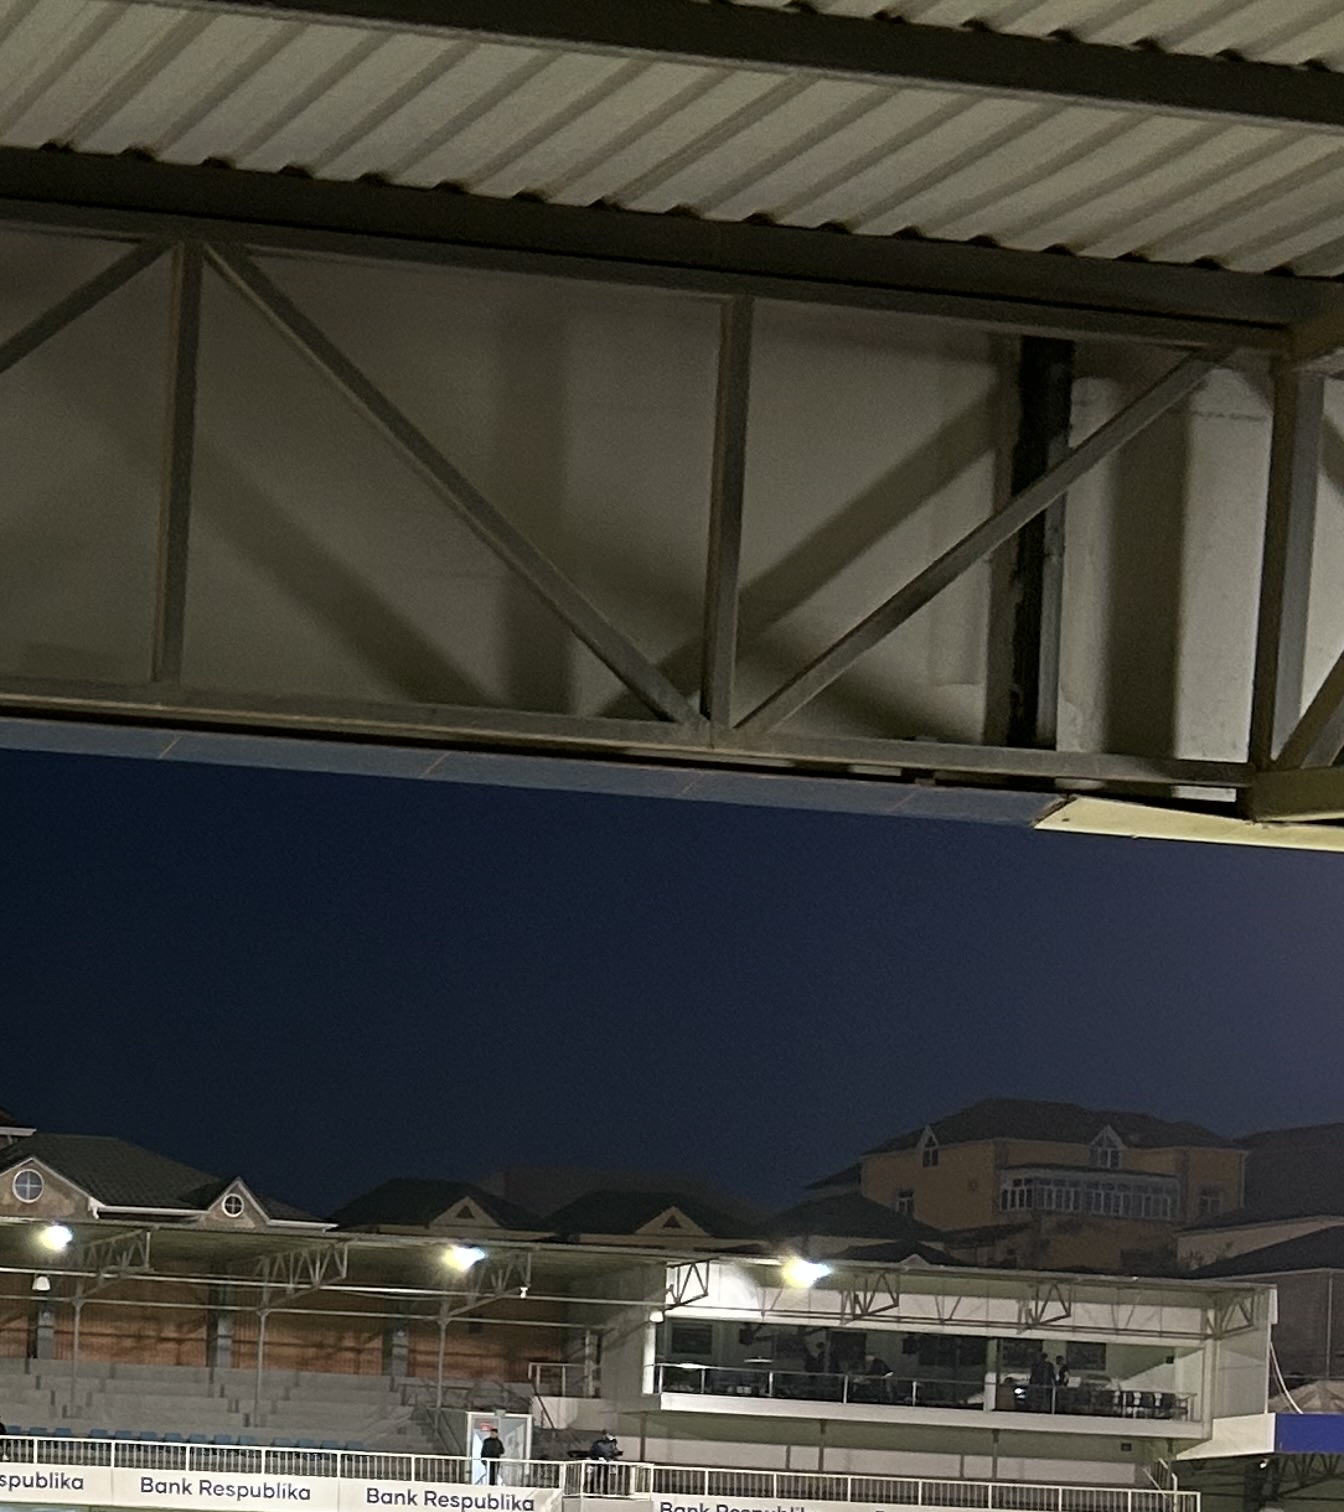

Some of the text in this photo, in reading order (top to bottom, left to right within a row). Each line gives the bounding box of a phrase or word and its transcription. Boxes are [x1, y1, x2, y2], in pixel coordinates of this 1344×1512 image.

[141, 1477, 311, 1502] Bank Respublika
[367, 1488, 535, 1512] Bank Respublika
